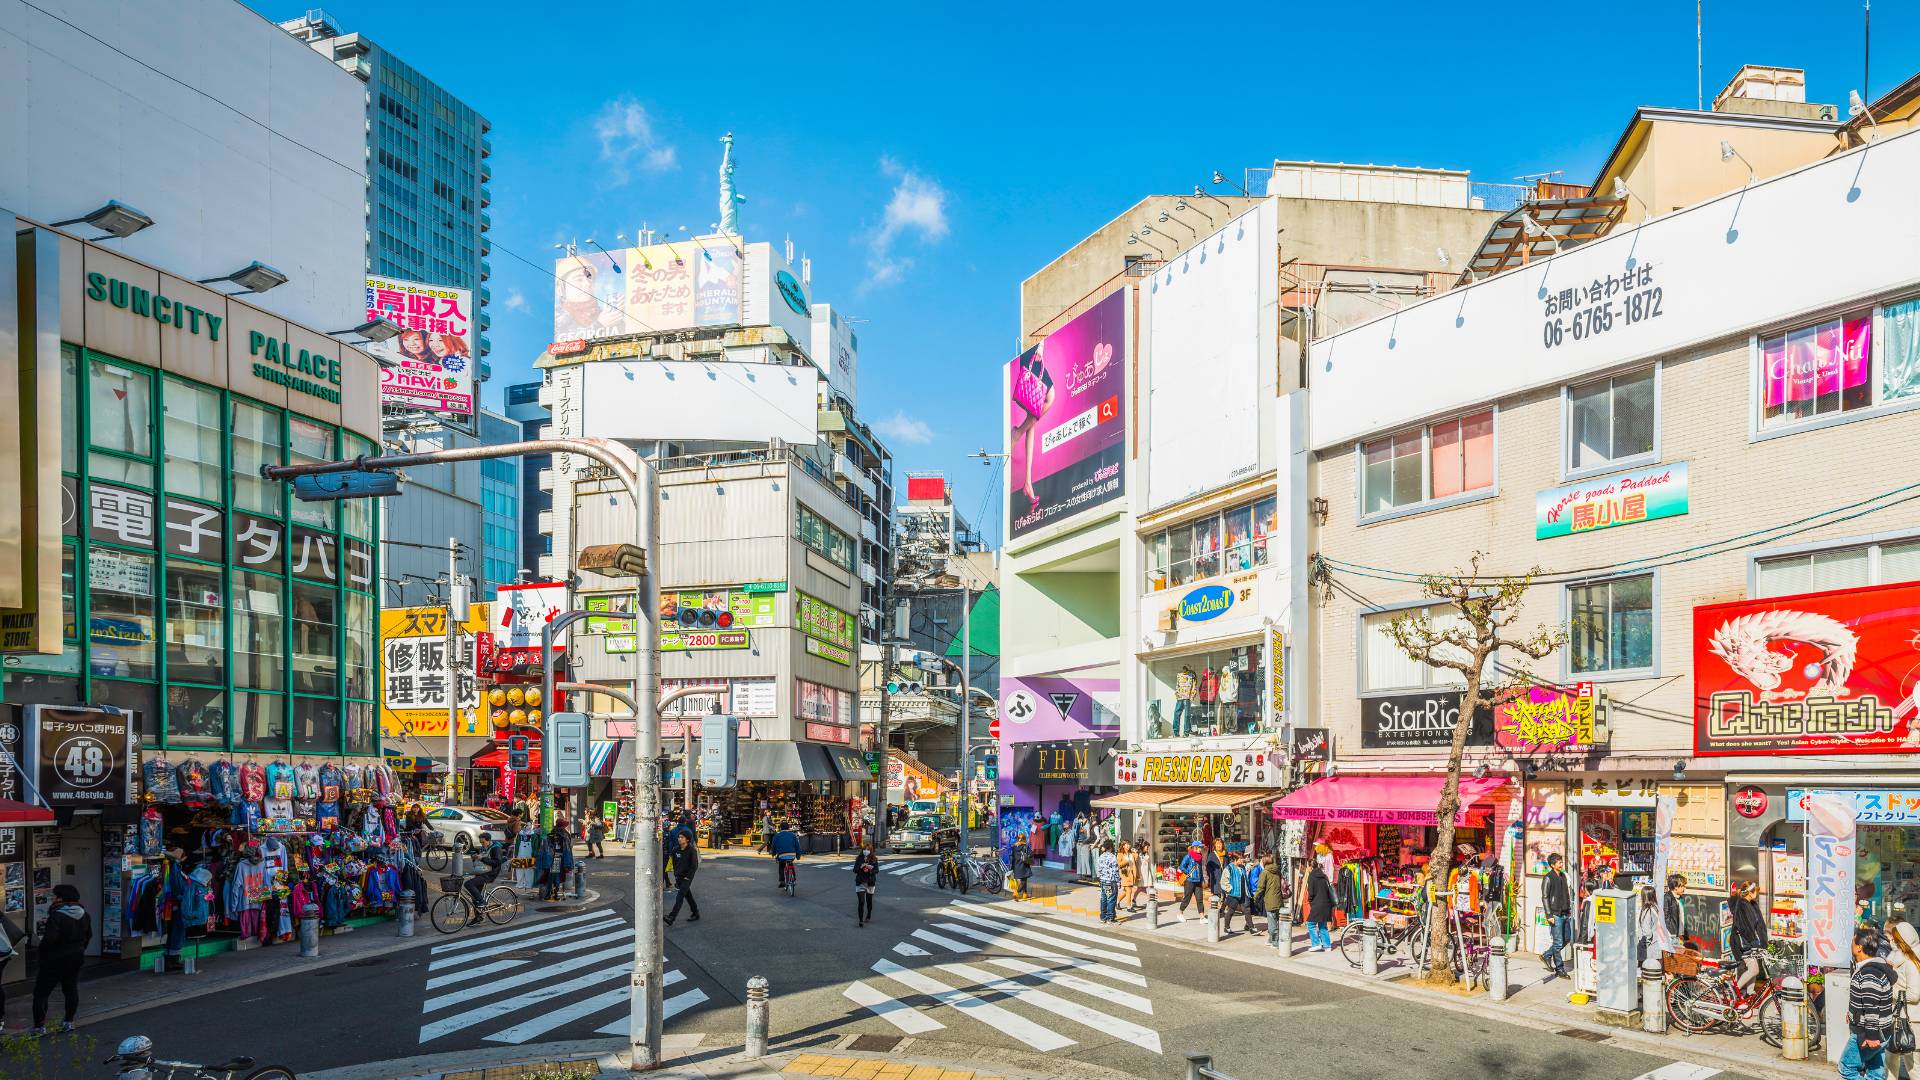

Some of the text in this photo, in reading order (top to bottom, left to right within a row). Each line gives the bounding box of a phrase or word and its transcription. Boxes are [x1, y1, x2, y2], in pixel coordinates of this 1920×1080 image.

[1544, 262, 1653, 317] お問い合わせは
[86, 272, 224, 342] SUNCITY
[377, 289, 467, 322] 高収入
[661, 302, 686, 316] ます
[1543, 286, 1663, 349] 06-6765-1872
[367, 309, 467, 337] お仕事探し
[249, 329, 342, 385] PALACE
[252, 362, 342, 405] SHINSAIBASHI
[1043, 414, 1093, 448] ぴゅあじょで稼ぐ
[1547, 470, 1672, 524] Horse goods Paddock
[1571, 493, 1648, 532] 馬小屋
[89, 485, 373, 585] 電子タバコ
[1239, 588, 1252, 602] 3F
[2, 613, 37, 629] WALKIN'
[4, 631, 32, 647] STORE
[387, 642, 414, 704] 修理
[418, 641, 445, 704] 販売
[485, 653, 542, 669] たこ焼き
[1272, 629, 1284, 712] FRESH CAPS
[42, 720, 126, 736] 電子タバコ専門店
[1378, 699, 1474, 731] StarRic
[1580, 699, 1591, 740] ラピス
[77, 740, 92, 748] VAPE
[1378, 730, 1441, 738] EXTENSION
[64, 747, 103, 776] 48
[1142, 754, 1249, 783] FRESH CAPS 2F
[52, 790, 114, 801] www.48style.jp
[75, 777, 94, 785] Japan
[1284, 807, 1438, 821] BOMBSHELL BOMBSHELL BOMBSHE
[1597, 899, 1612, 917] 占
